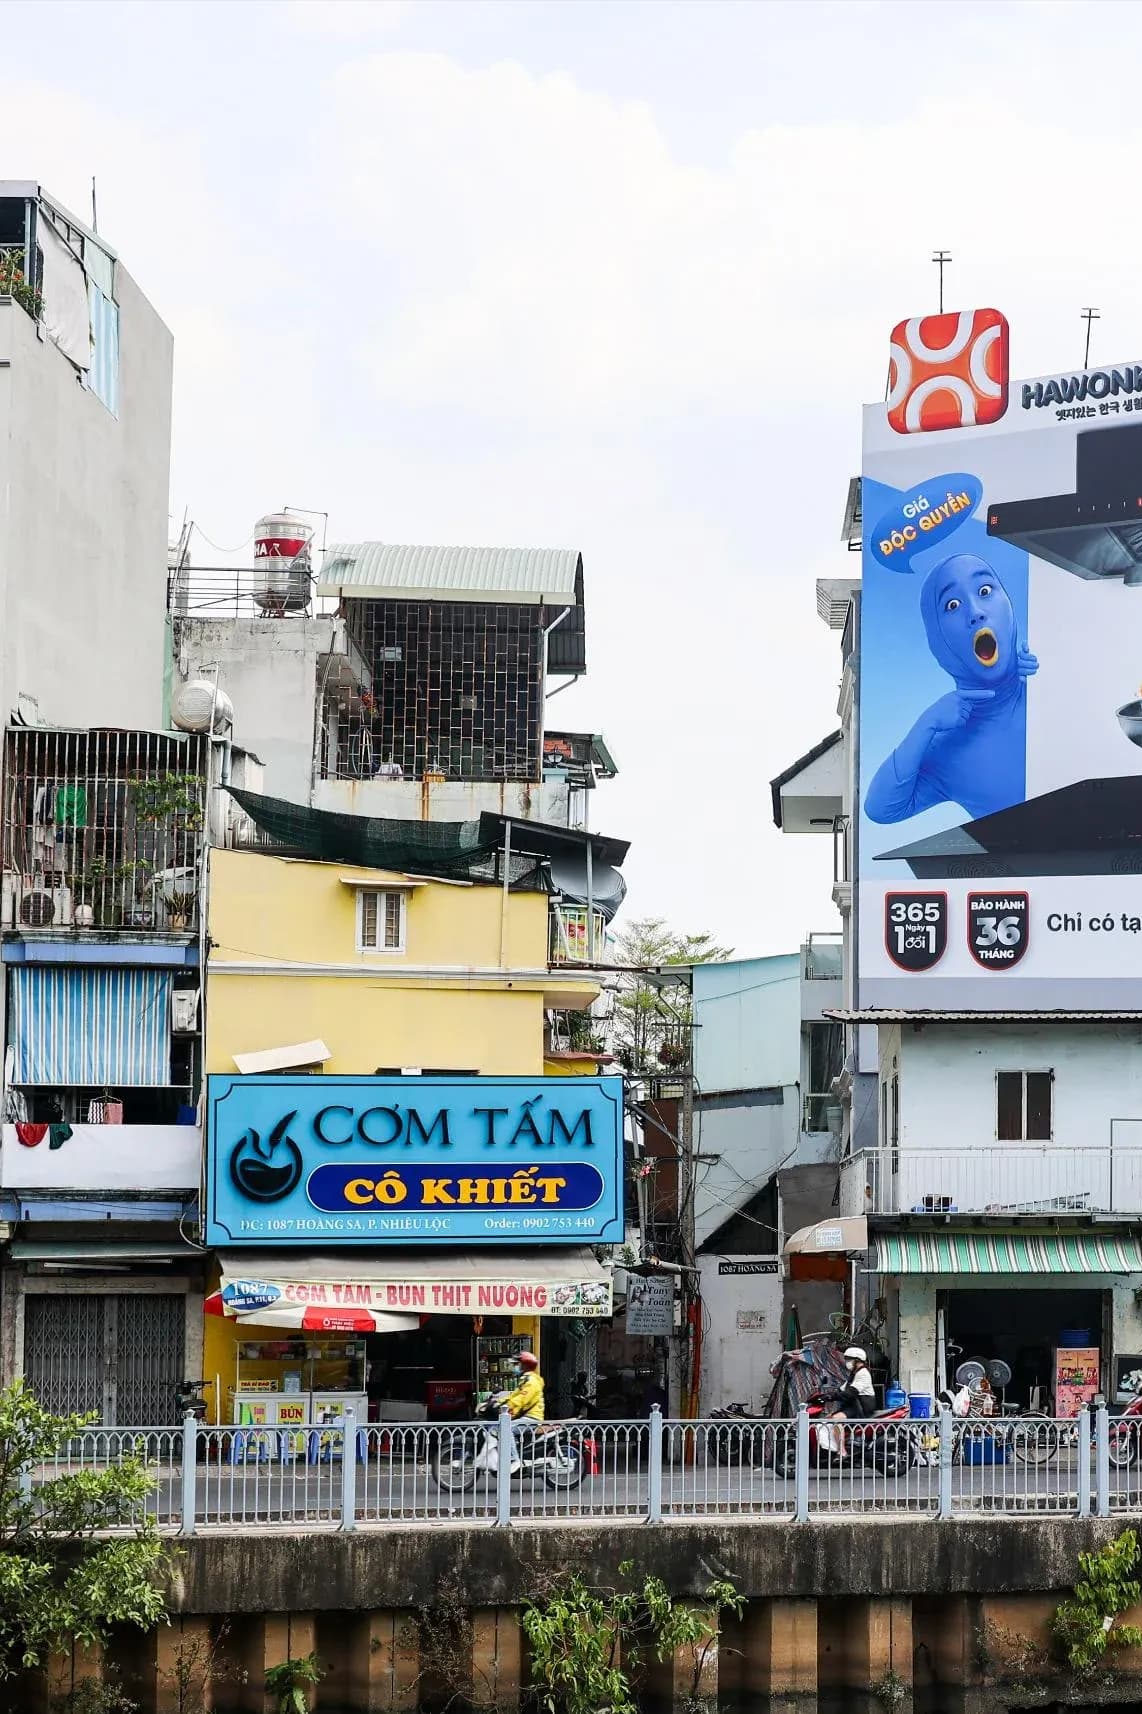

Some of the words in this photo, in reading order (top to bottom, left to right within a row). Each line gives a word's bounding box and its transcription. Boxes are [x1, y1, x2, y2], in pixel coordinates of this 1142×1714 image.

[1099, 401, 1120, 415] 한국
[903, 495, 930, 518] Giá
[880, 525, 917, 556] ĐỘC
[918, 491, 971, 531] QUYỀN
[890, 902, 940, 922] 365
[971, 898, 993, 911] BẢO
[995, 898, 1025, 910] HÀNH
[905, 924, 926, 933] Ngày
[975, 916, 1021, 946] 36
[1047, 912, 1082, 932] Chỉ
[1088, 913, 1115, 932] có
[894, 925, 905, 953] 1
[926, 925, 936, 953] 1
[979, 948, 1014, 959] THÁNG
[313, 1103, 453, 1146] CƠM
[472, 1093, 596, 1146] TẤM
[343, 1169, 408, 1205] CÔ
[420, 1166, 566, 1205] KHIẾT
[267, 1219, 294, 1230] 1087
[296, 1217, 345, 1230] HOÀNG
[347, 1219, 366, 1231] SA,
[367, 1219, 378, 1230] P.
[380, 1216, 424, 1230] NHIÊU
[424, 1218, 451, 1232] LỘC
[484, 1218, 521, 1229] Order:
[523, 1218, 550, 1228] 0902
[552, 1218, 572, 1228] 753
[574, 1217, 595, 1228] 440
[233, 1283, 268, 1296] 1087
[431, 1285, 472, 1312] THỊT
[280, 1406, 303, 1419] BÚN
